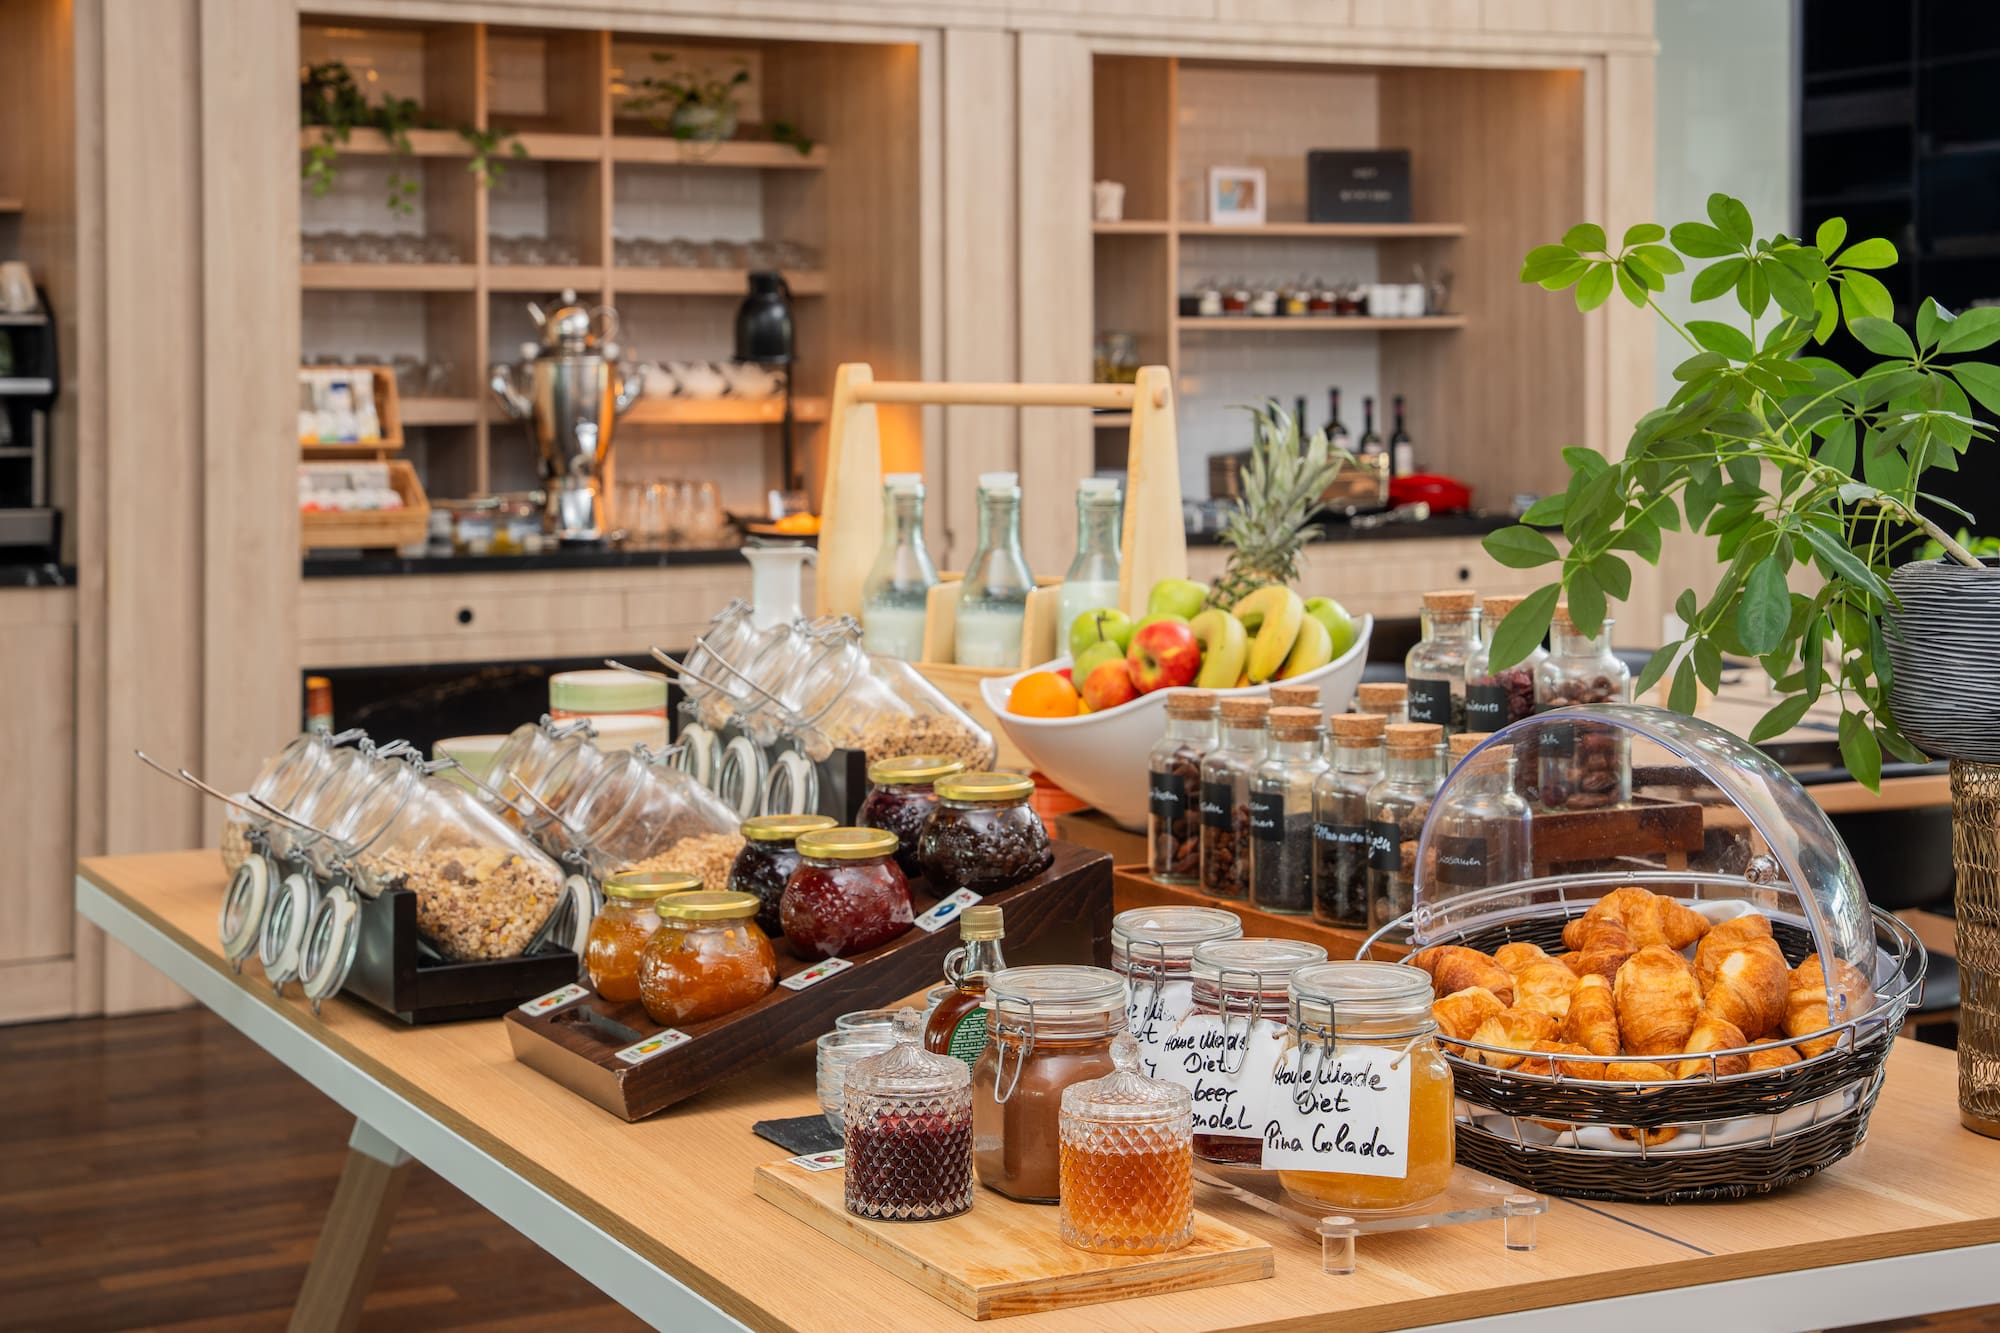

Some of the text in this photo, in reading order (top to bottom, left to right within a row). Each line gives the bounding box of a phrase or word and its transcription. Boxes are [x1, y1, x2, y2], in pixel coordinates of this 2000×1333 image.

[1191, 1078, 1238, 1103] beer
[1296, 1088, 1351, 1115] Diet
[1264, 1119, 1395, 1158] Pina Colada
